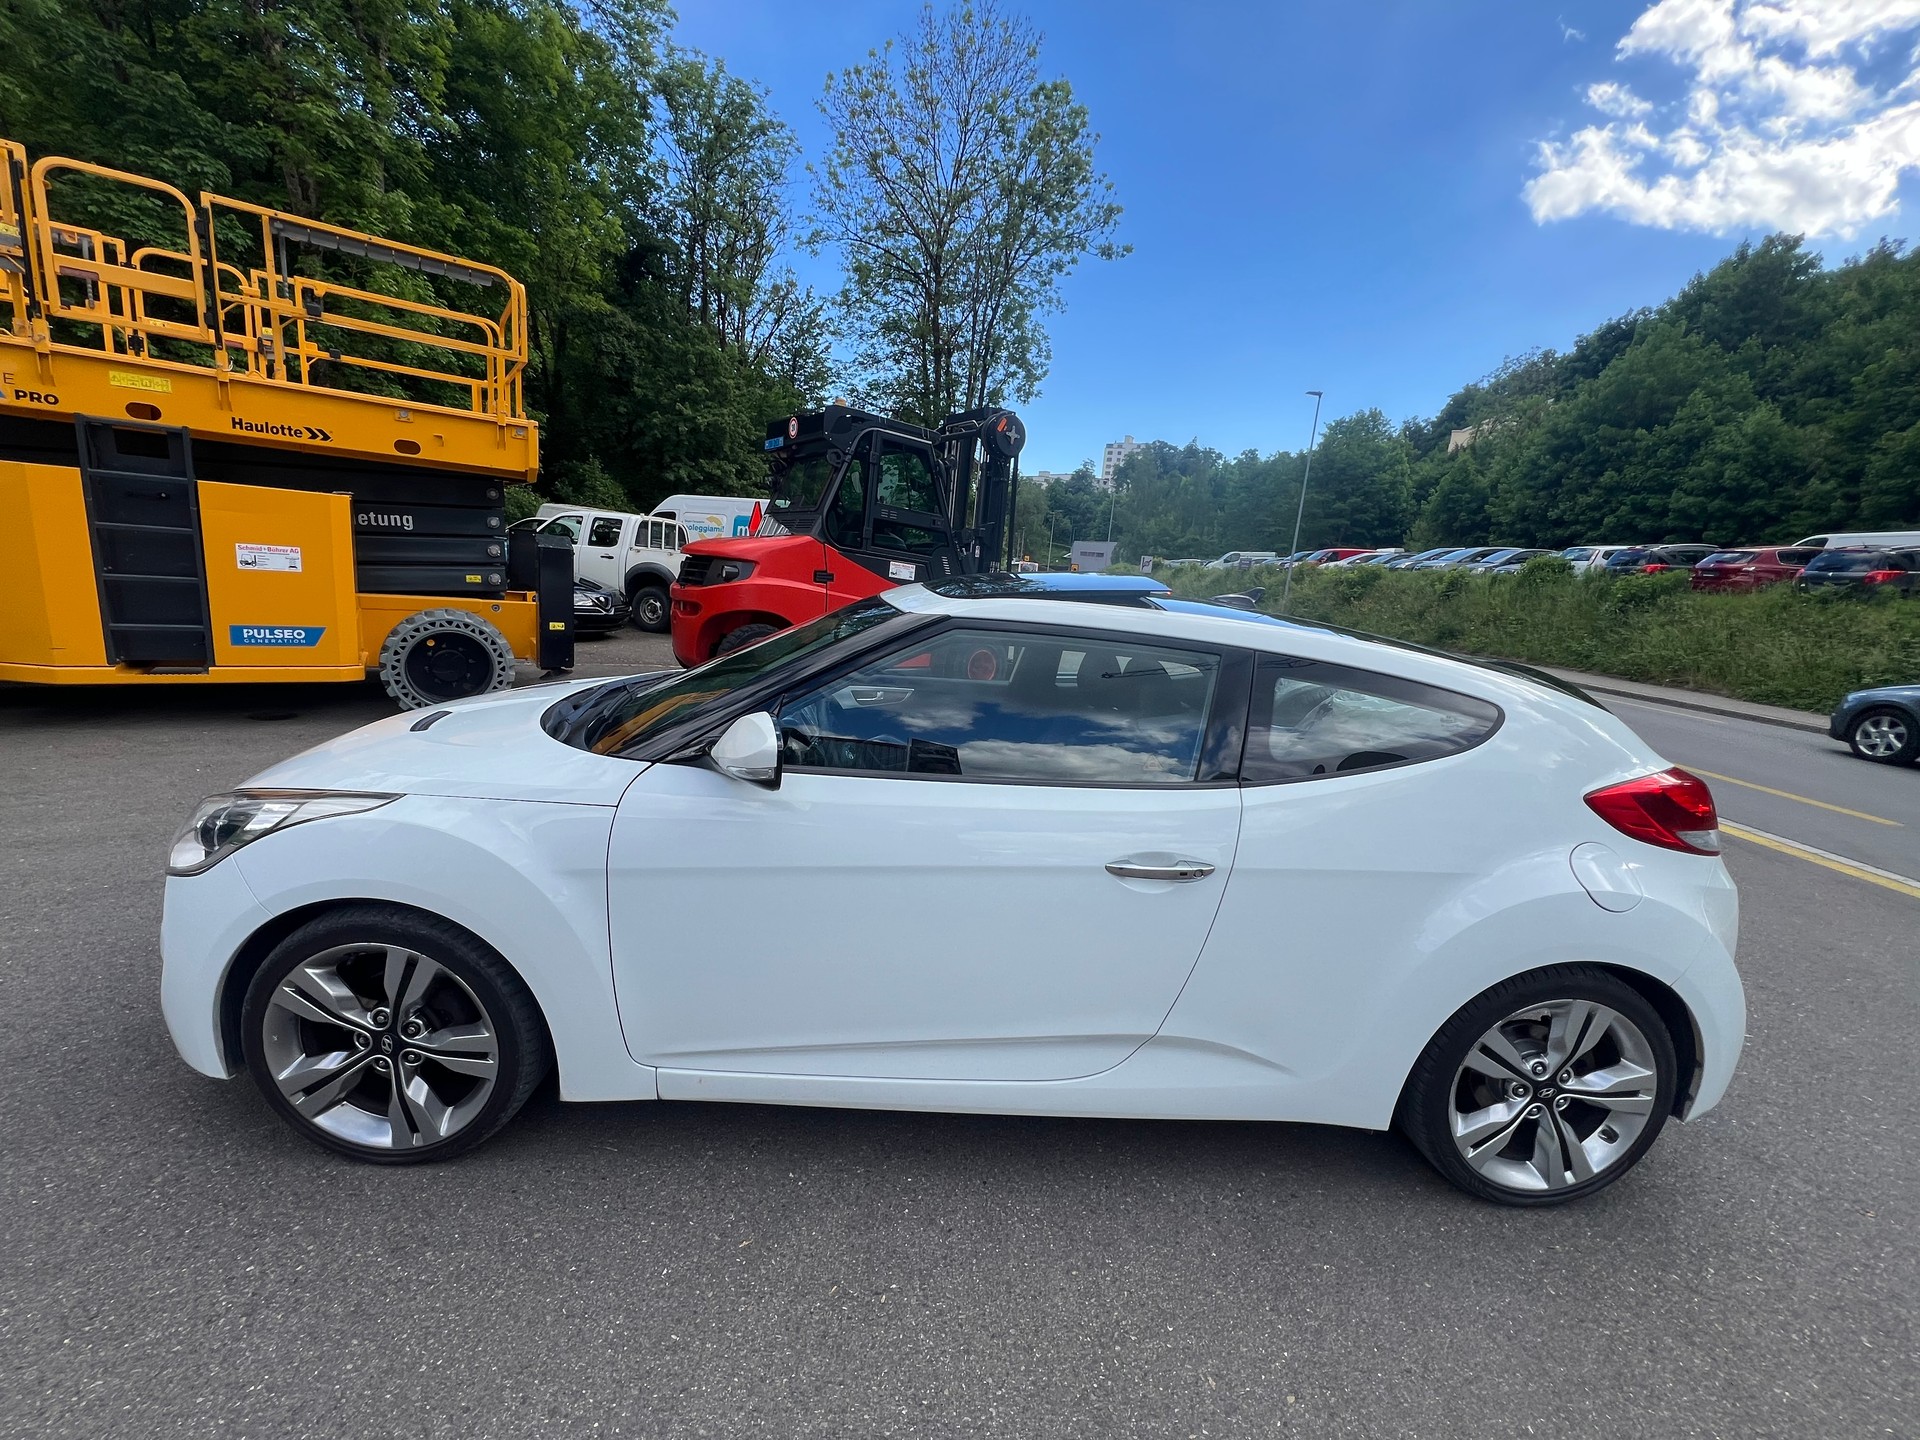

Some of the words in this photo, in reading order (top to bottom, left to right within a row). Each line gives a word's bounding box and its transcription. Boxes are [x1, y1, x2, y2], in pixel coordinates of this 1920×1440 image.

[14, 389, 60, 405] PRO
[231, 416, 303, 438] Haulotte
[243, 628, 306, 639] PULSEO
